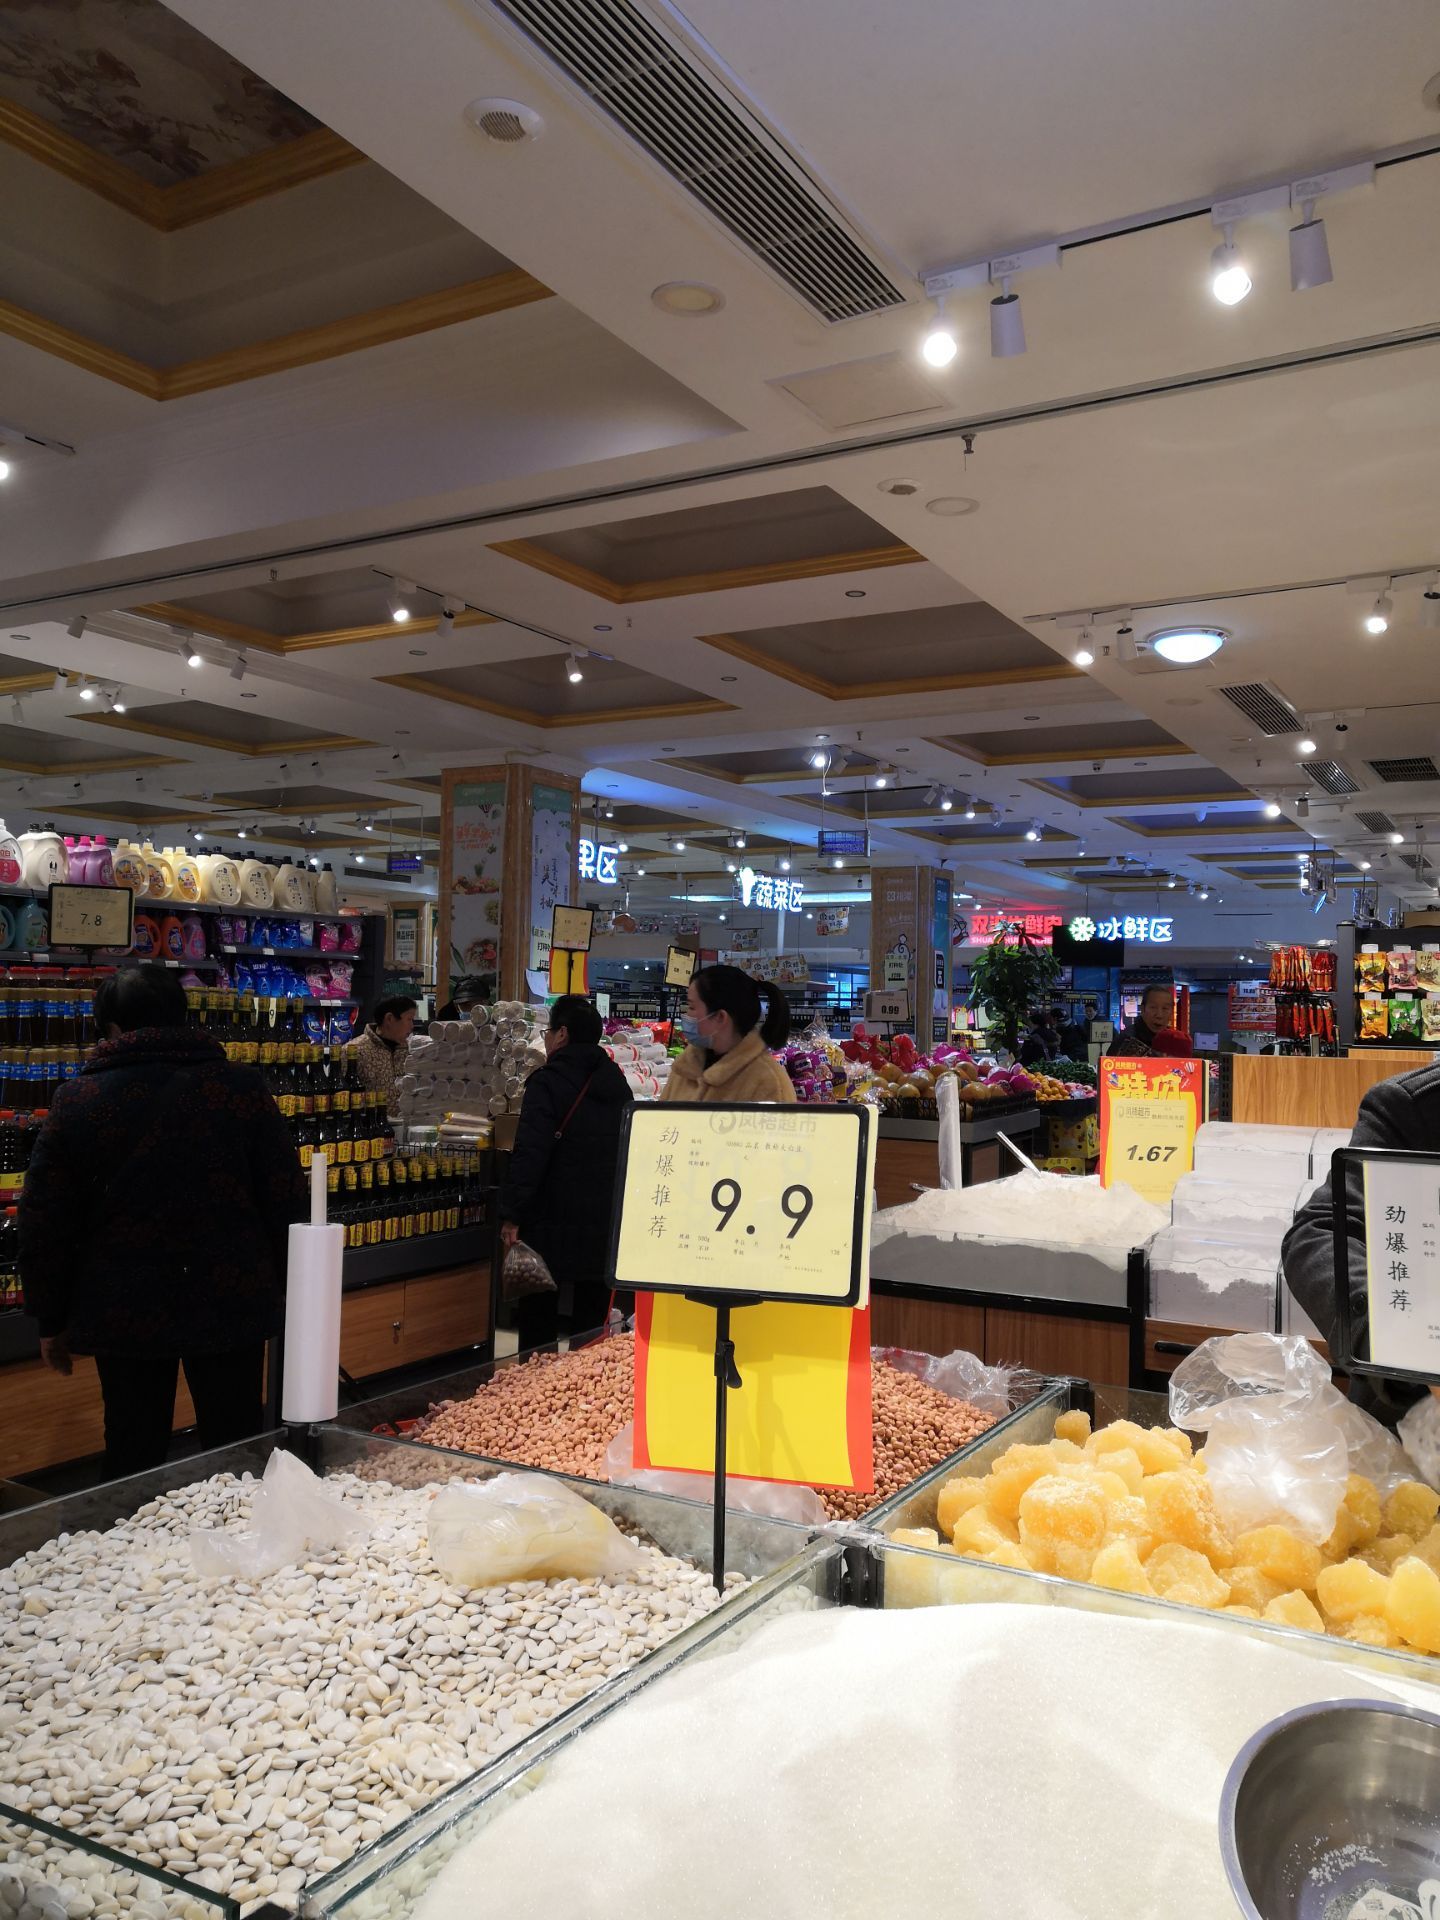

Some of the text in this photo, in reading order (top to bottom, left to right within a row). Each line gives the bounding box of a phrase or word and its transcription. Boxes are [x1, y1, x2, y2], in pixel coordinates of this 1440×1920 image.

[756, 876, 804, 912] 蔬菜区
[80, 913, 102, 927] 7.8
[1099, 916, 1174, 942] 冰鲜区
[1126, 1144, 1178, 1163] 1.67
[647, 1126, 679, 1238] 劲爆推荐
[711, 1178, 813, 1240] 9.9
[1384, 1205, 1412, 1311] 劲爆推荐
